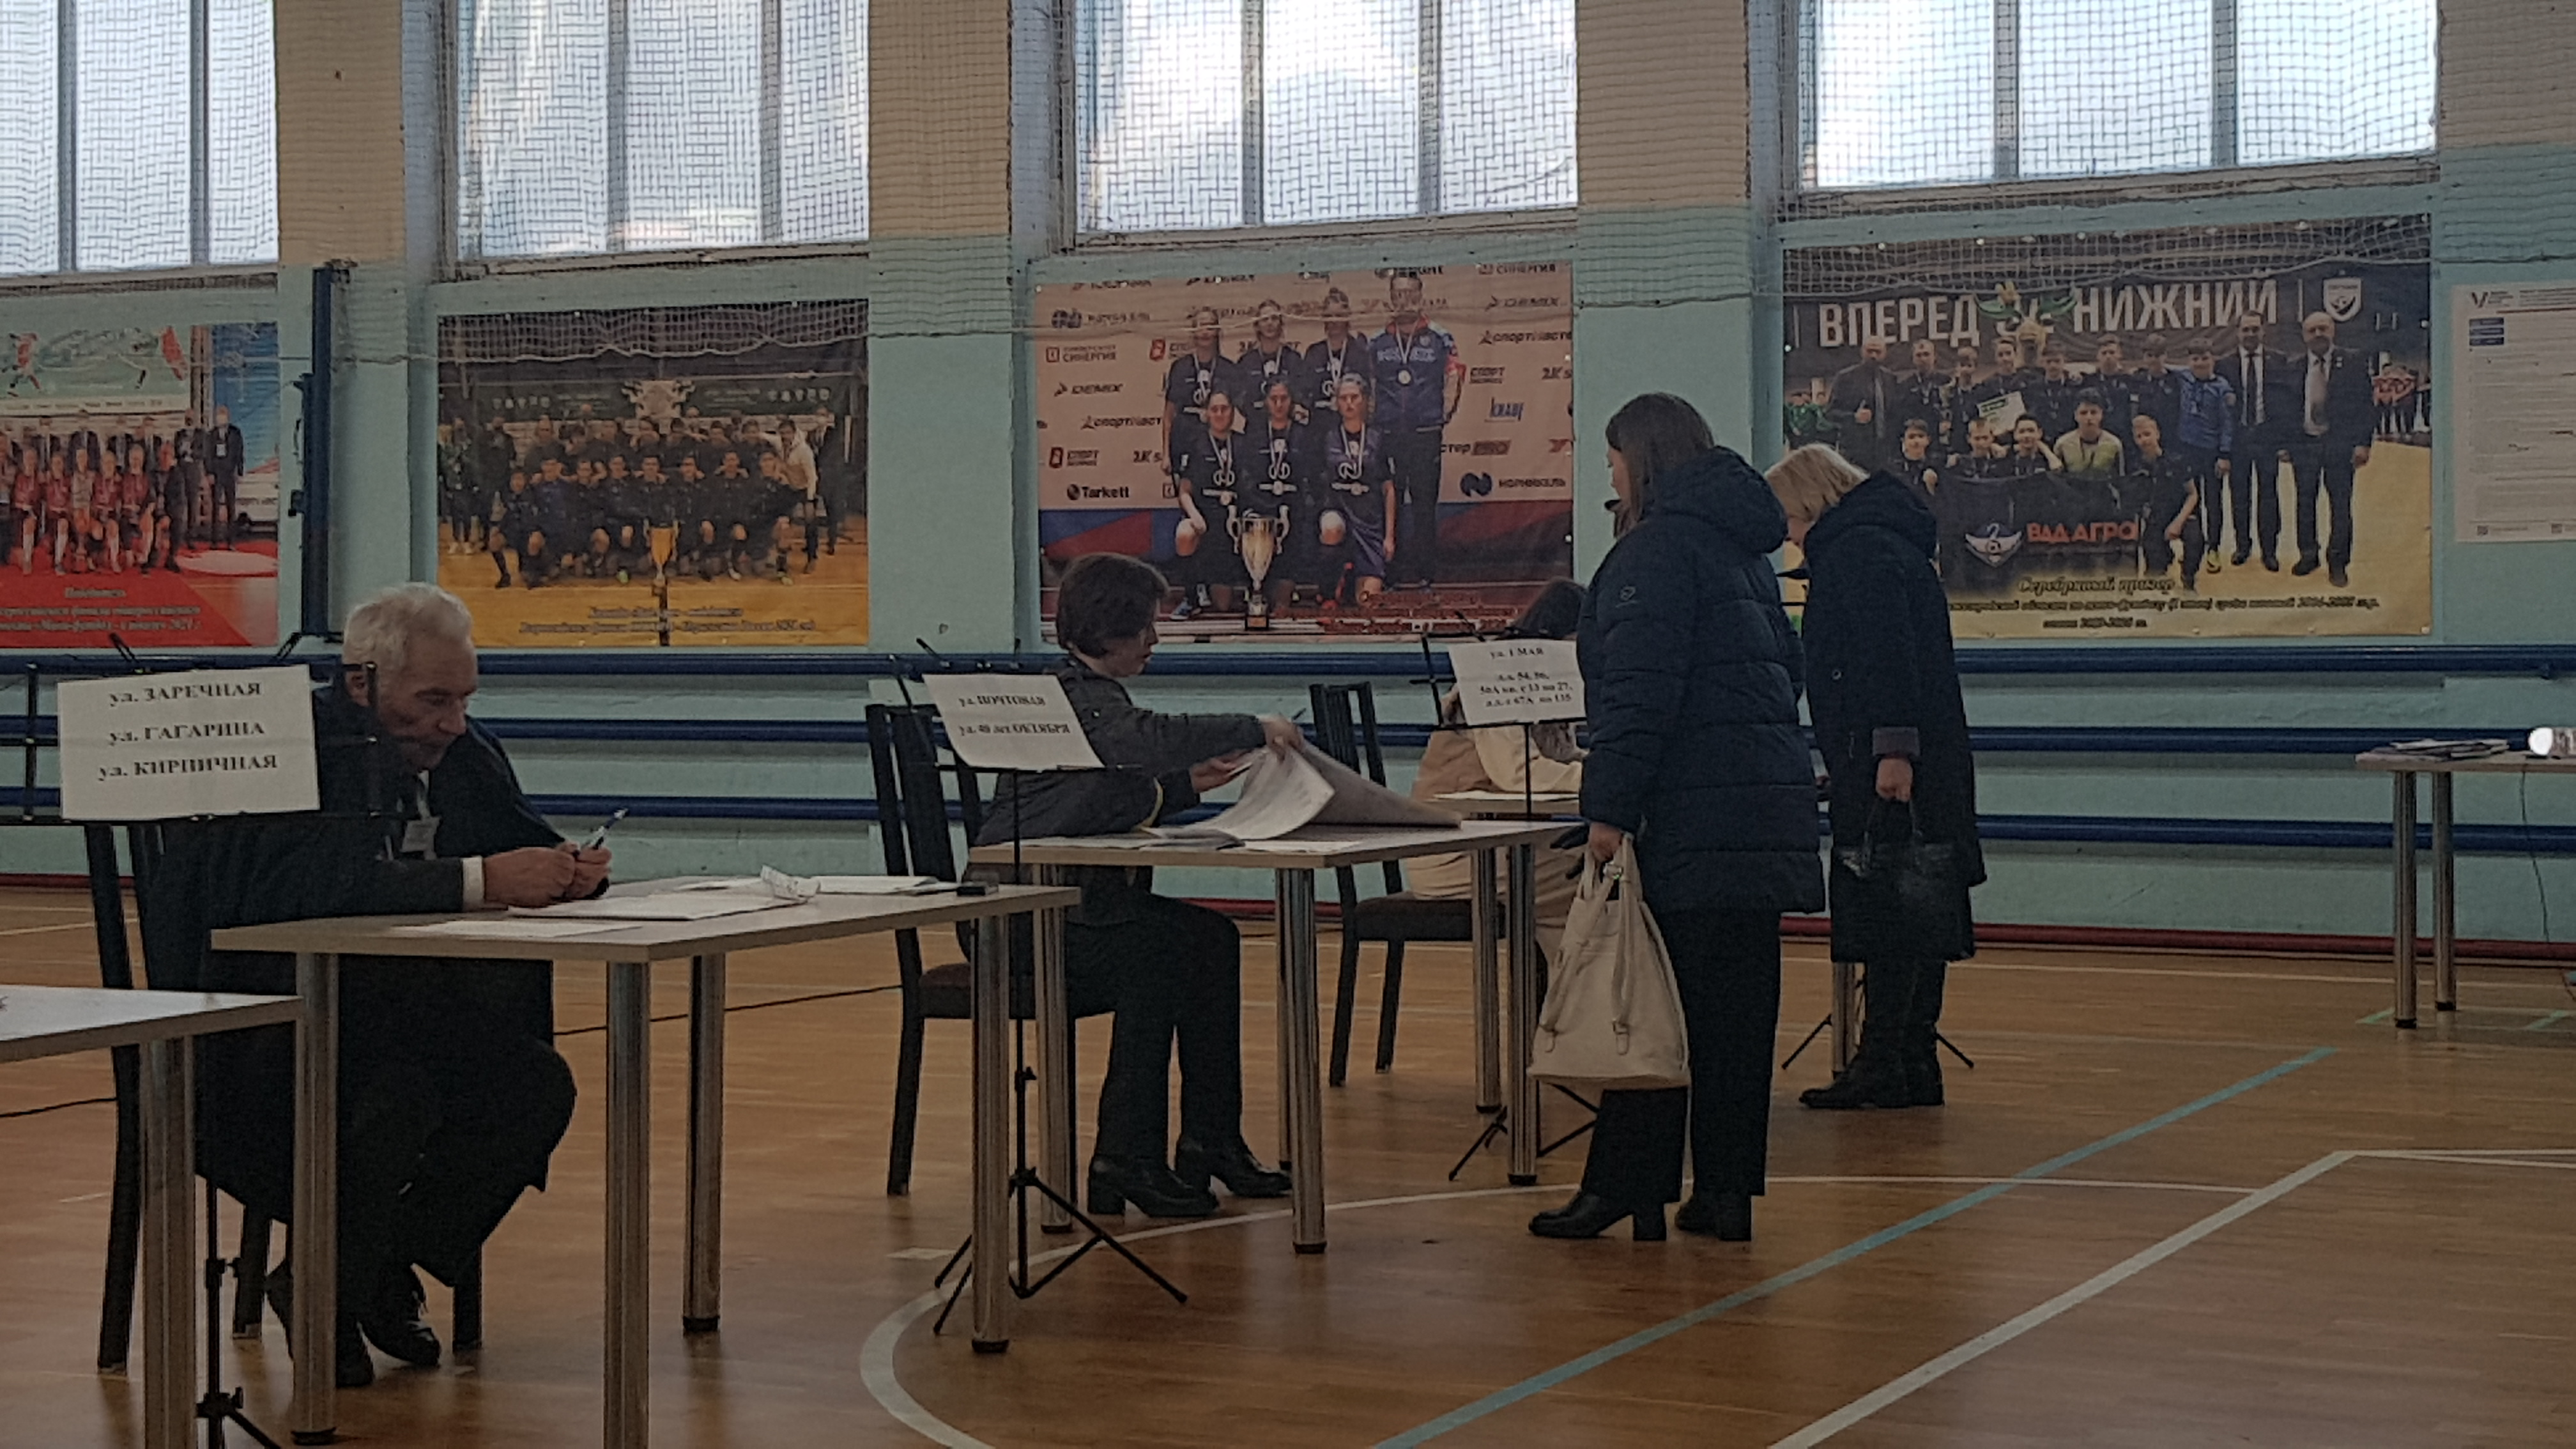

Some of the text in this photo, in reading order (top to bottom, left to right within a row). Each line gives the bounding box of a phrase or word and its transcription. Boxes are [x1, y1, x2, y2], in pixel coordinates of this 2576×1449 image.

[1819, 295, 1981, 348] ВПЕРЕД
[1062, 351, 1117, 363] СИНЕРГИЯ
[1081, 486, 1130, 498] Tarkett
[2071, 520, 2138, 542] АГРО
[109, 682, 262, 708] ул. ЗАРЕЧНАЯ
[977, 695, 1046, 706] ПОЧТОВАЯ
[108, 721, 265, 747] ул. ГАГАРИНА
[1012, 723, 1071, 734] ОКТЯБРЯ
[97, 754, 279, 782] ул. КИРПИЧНАЯ
